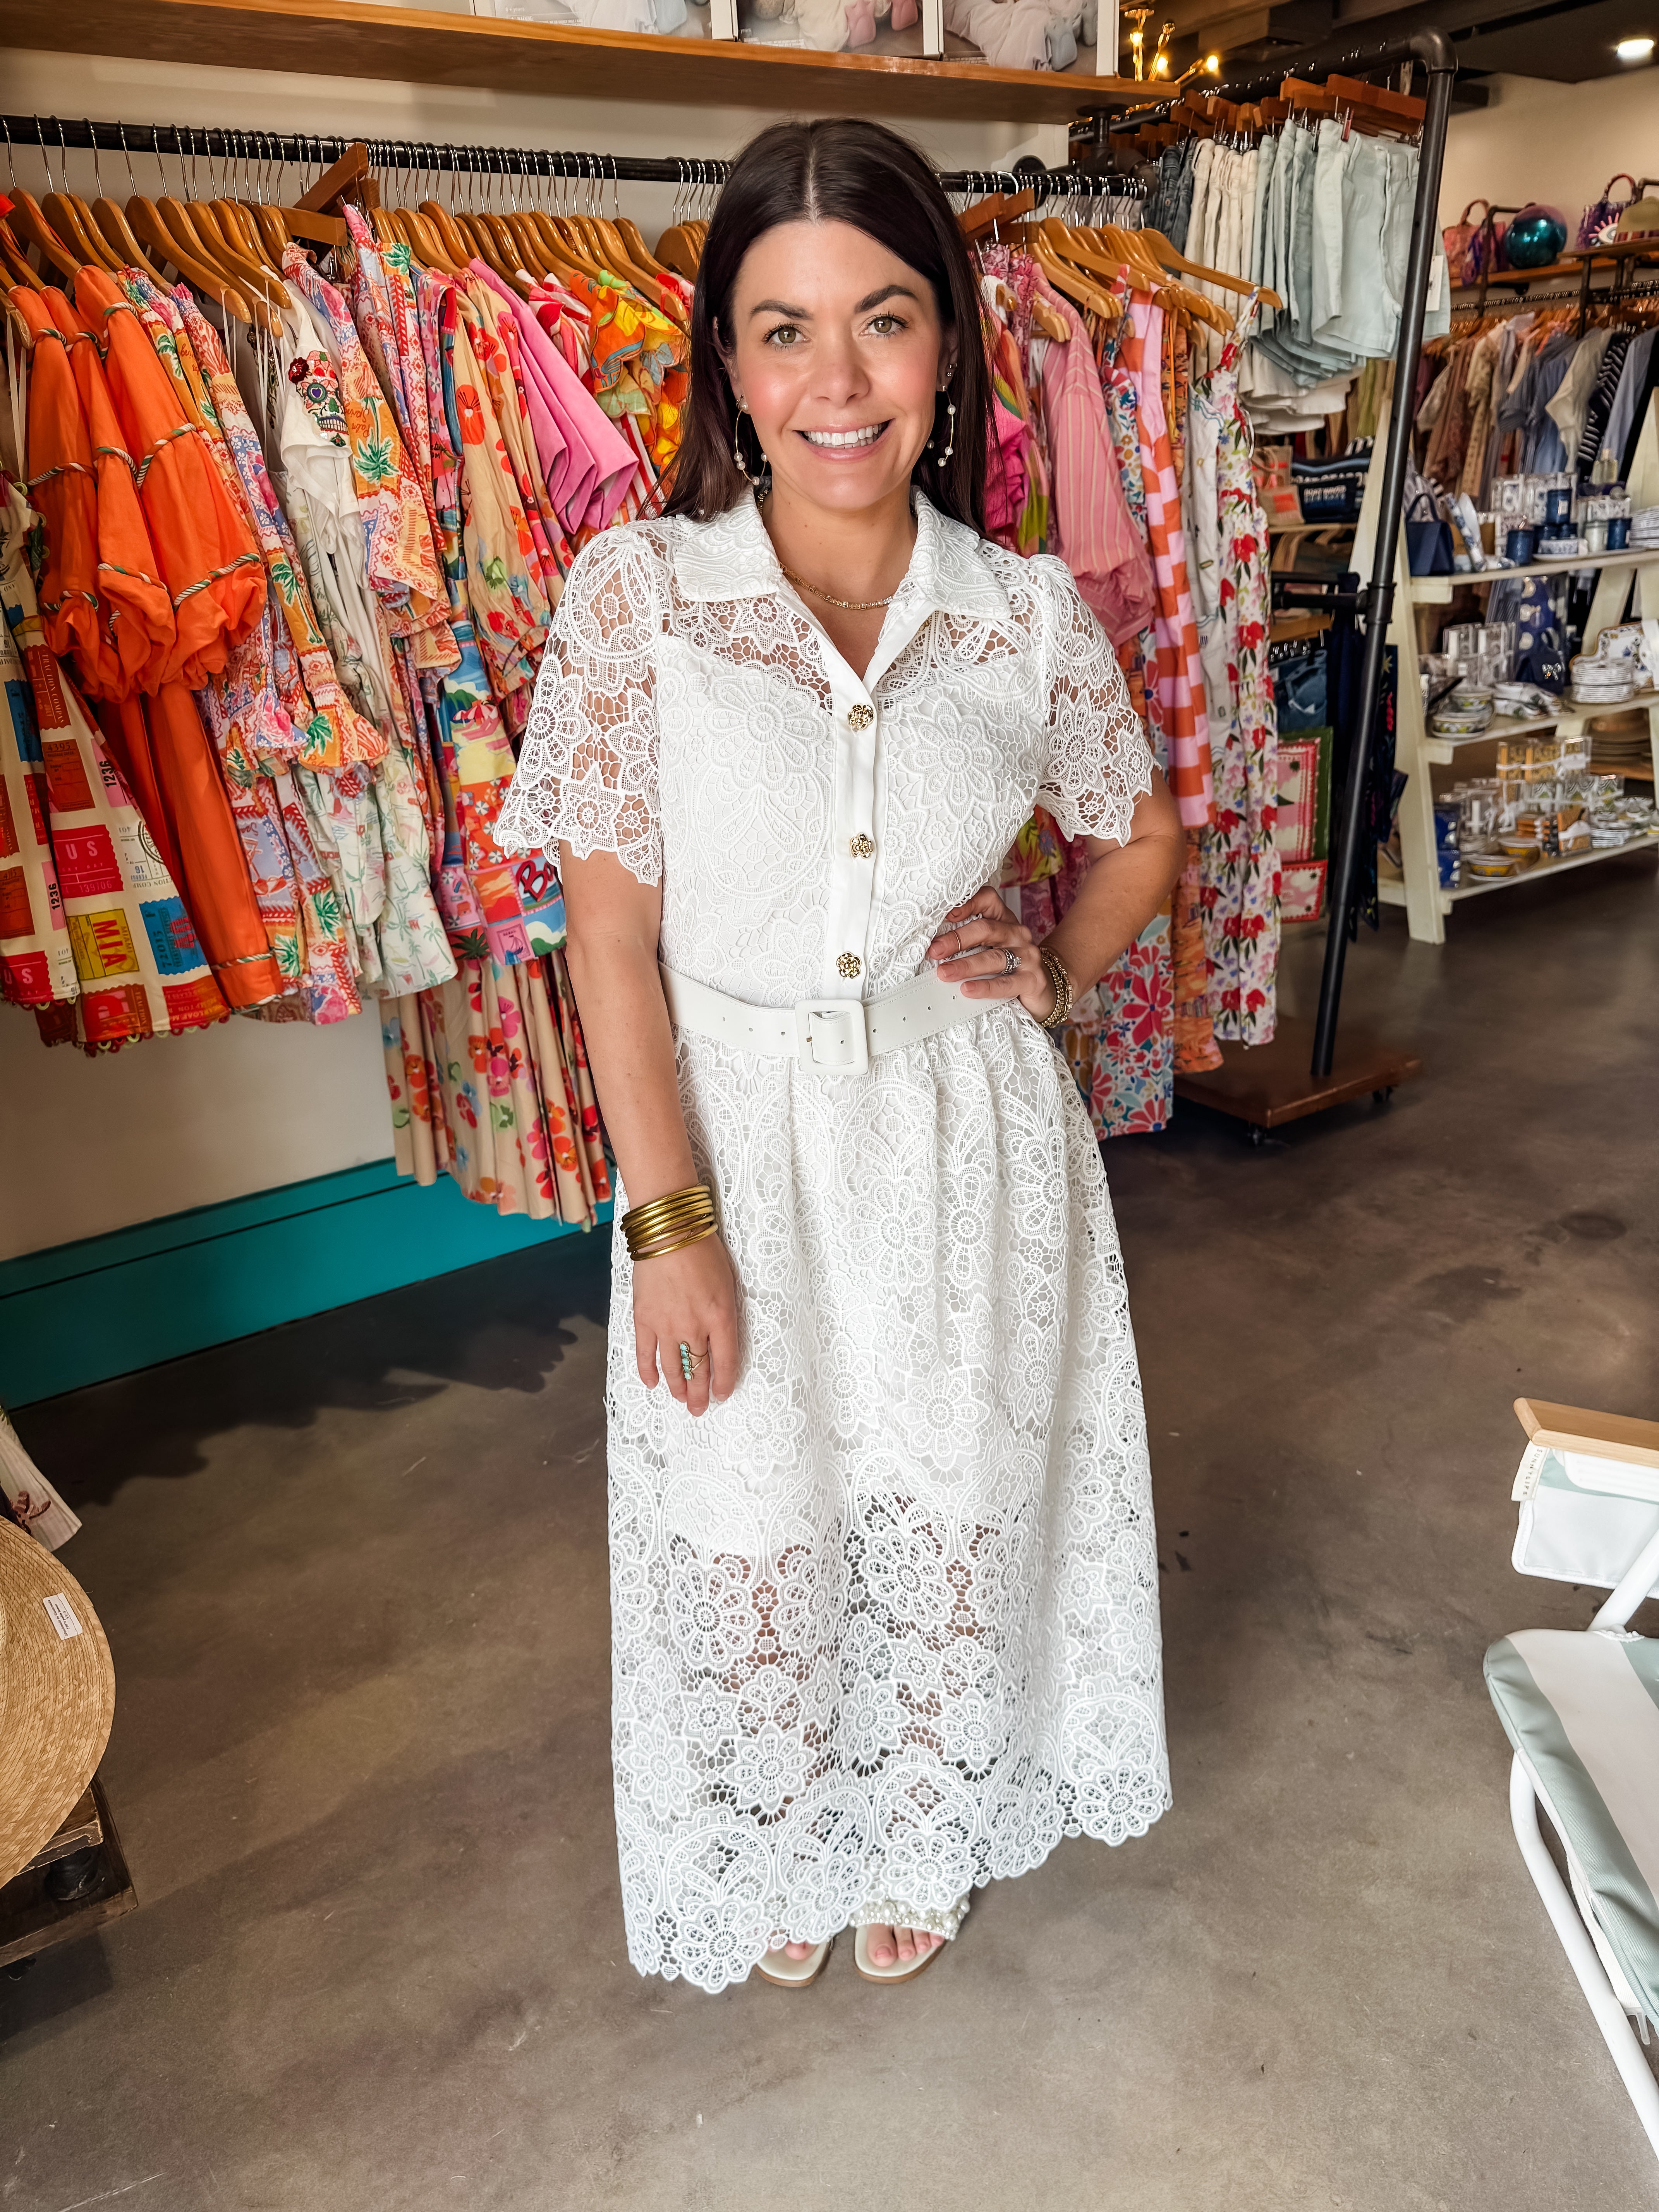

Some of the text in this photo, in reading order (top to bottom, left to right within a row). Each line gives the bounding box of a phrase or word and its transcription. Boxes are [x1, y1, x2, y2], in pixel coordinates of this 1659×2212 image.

[352, 422, 370, 438] Palm
[42, 654, 56, 691] TRACTION
[47, 742, 71, 752] 4395
[99, 760, 117, 787] 1236
[48, 883, 60, 910] 1236
[92, 919, 127, 968] MIA
[120, 926, 133, 953] MIAMI
[153, 931, 172, 968] 72015
[135, 991, 148, 1026] TRACTION
[1522, 1448, 1543, 1495] SUNNYLIFE
